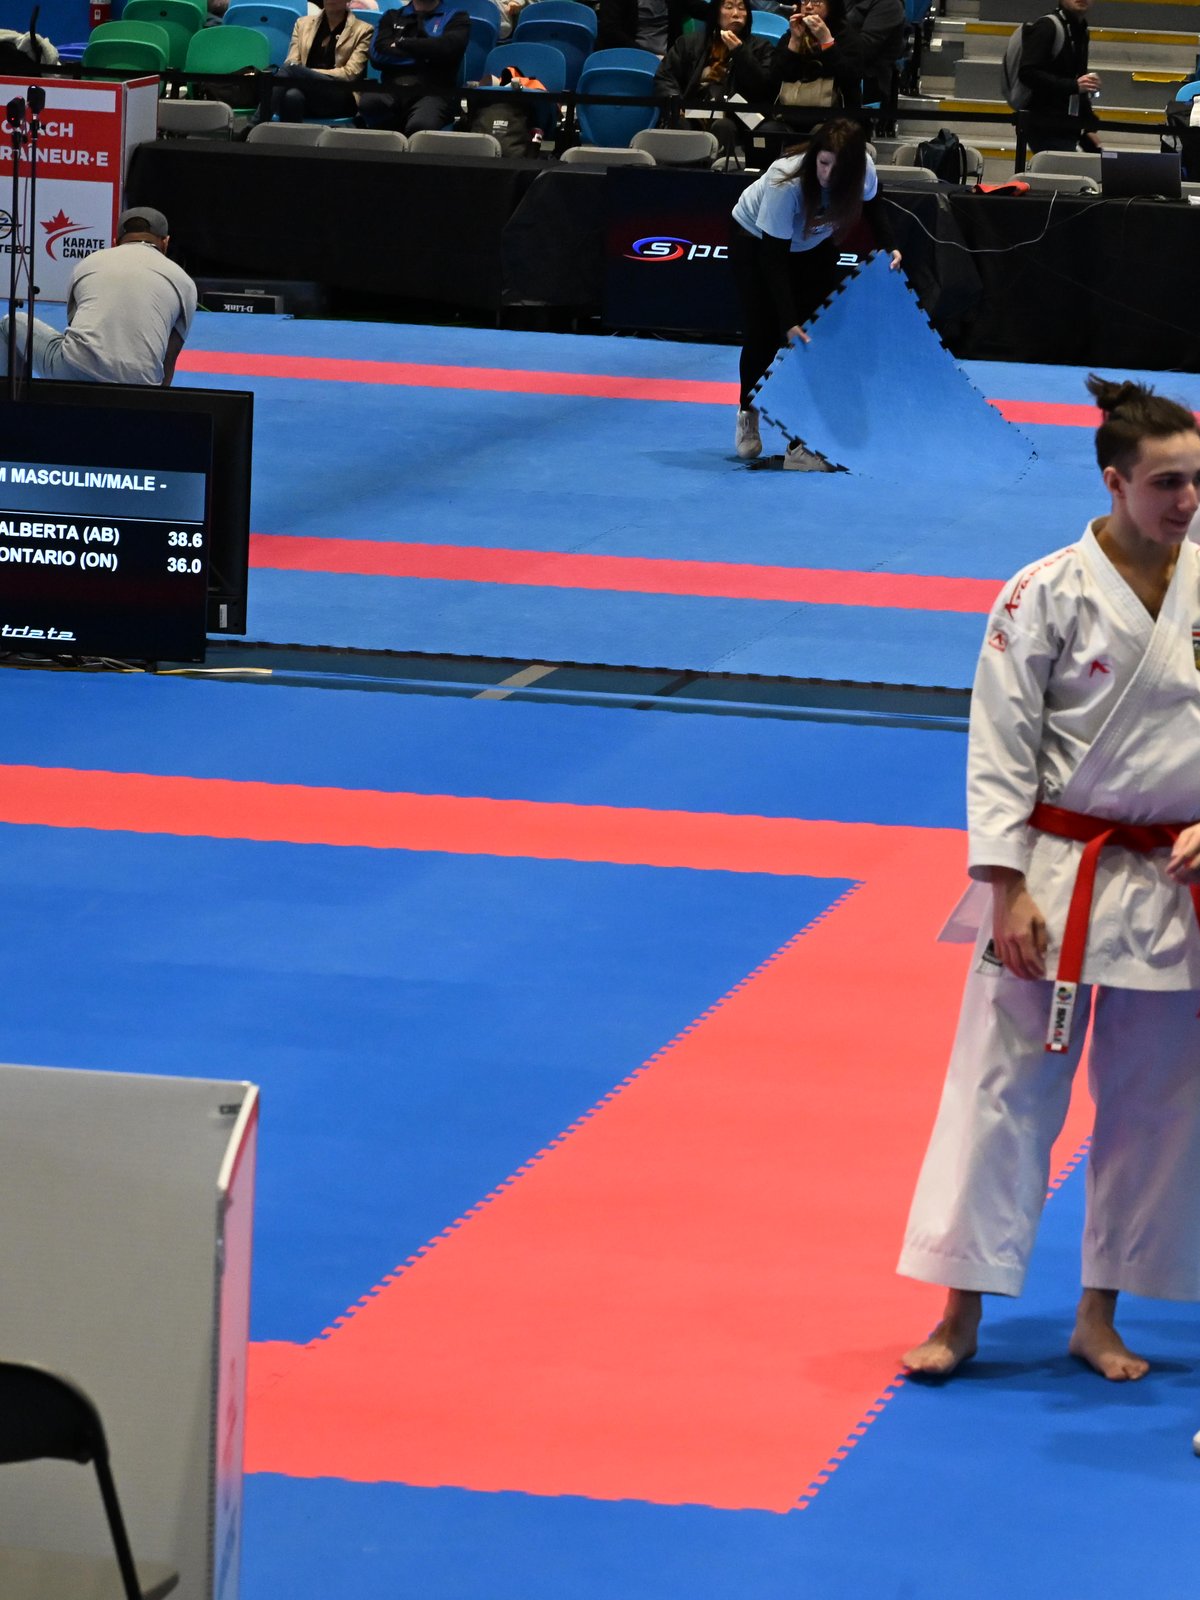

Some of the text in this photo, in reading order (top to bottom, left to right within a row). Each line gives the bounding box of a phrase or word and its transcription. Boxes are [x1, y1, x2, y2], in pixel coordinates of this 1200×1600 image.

[63, 237, 105, 250] KARATE
[223, 303, 254, 313] D-Link
[11, 467, 156, 491] MASCULIN/MALE
[0, 521, 203, 548] ALBERTA (AB) 38.6
[0, 546, 202, 574] ONTARIO (ON) 36.0
